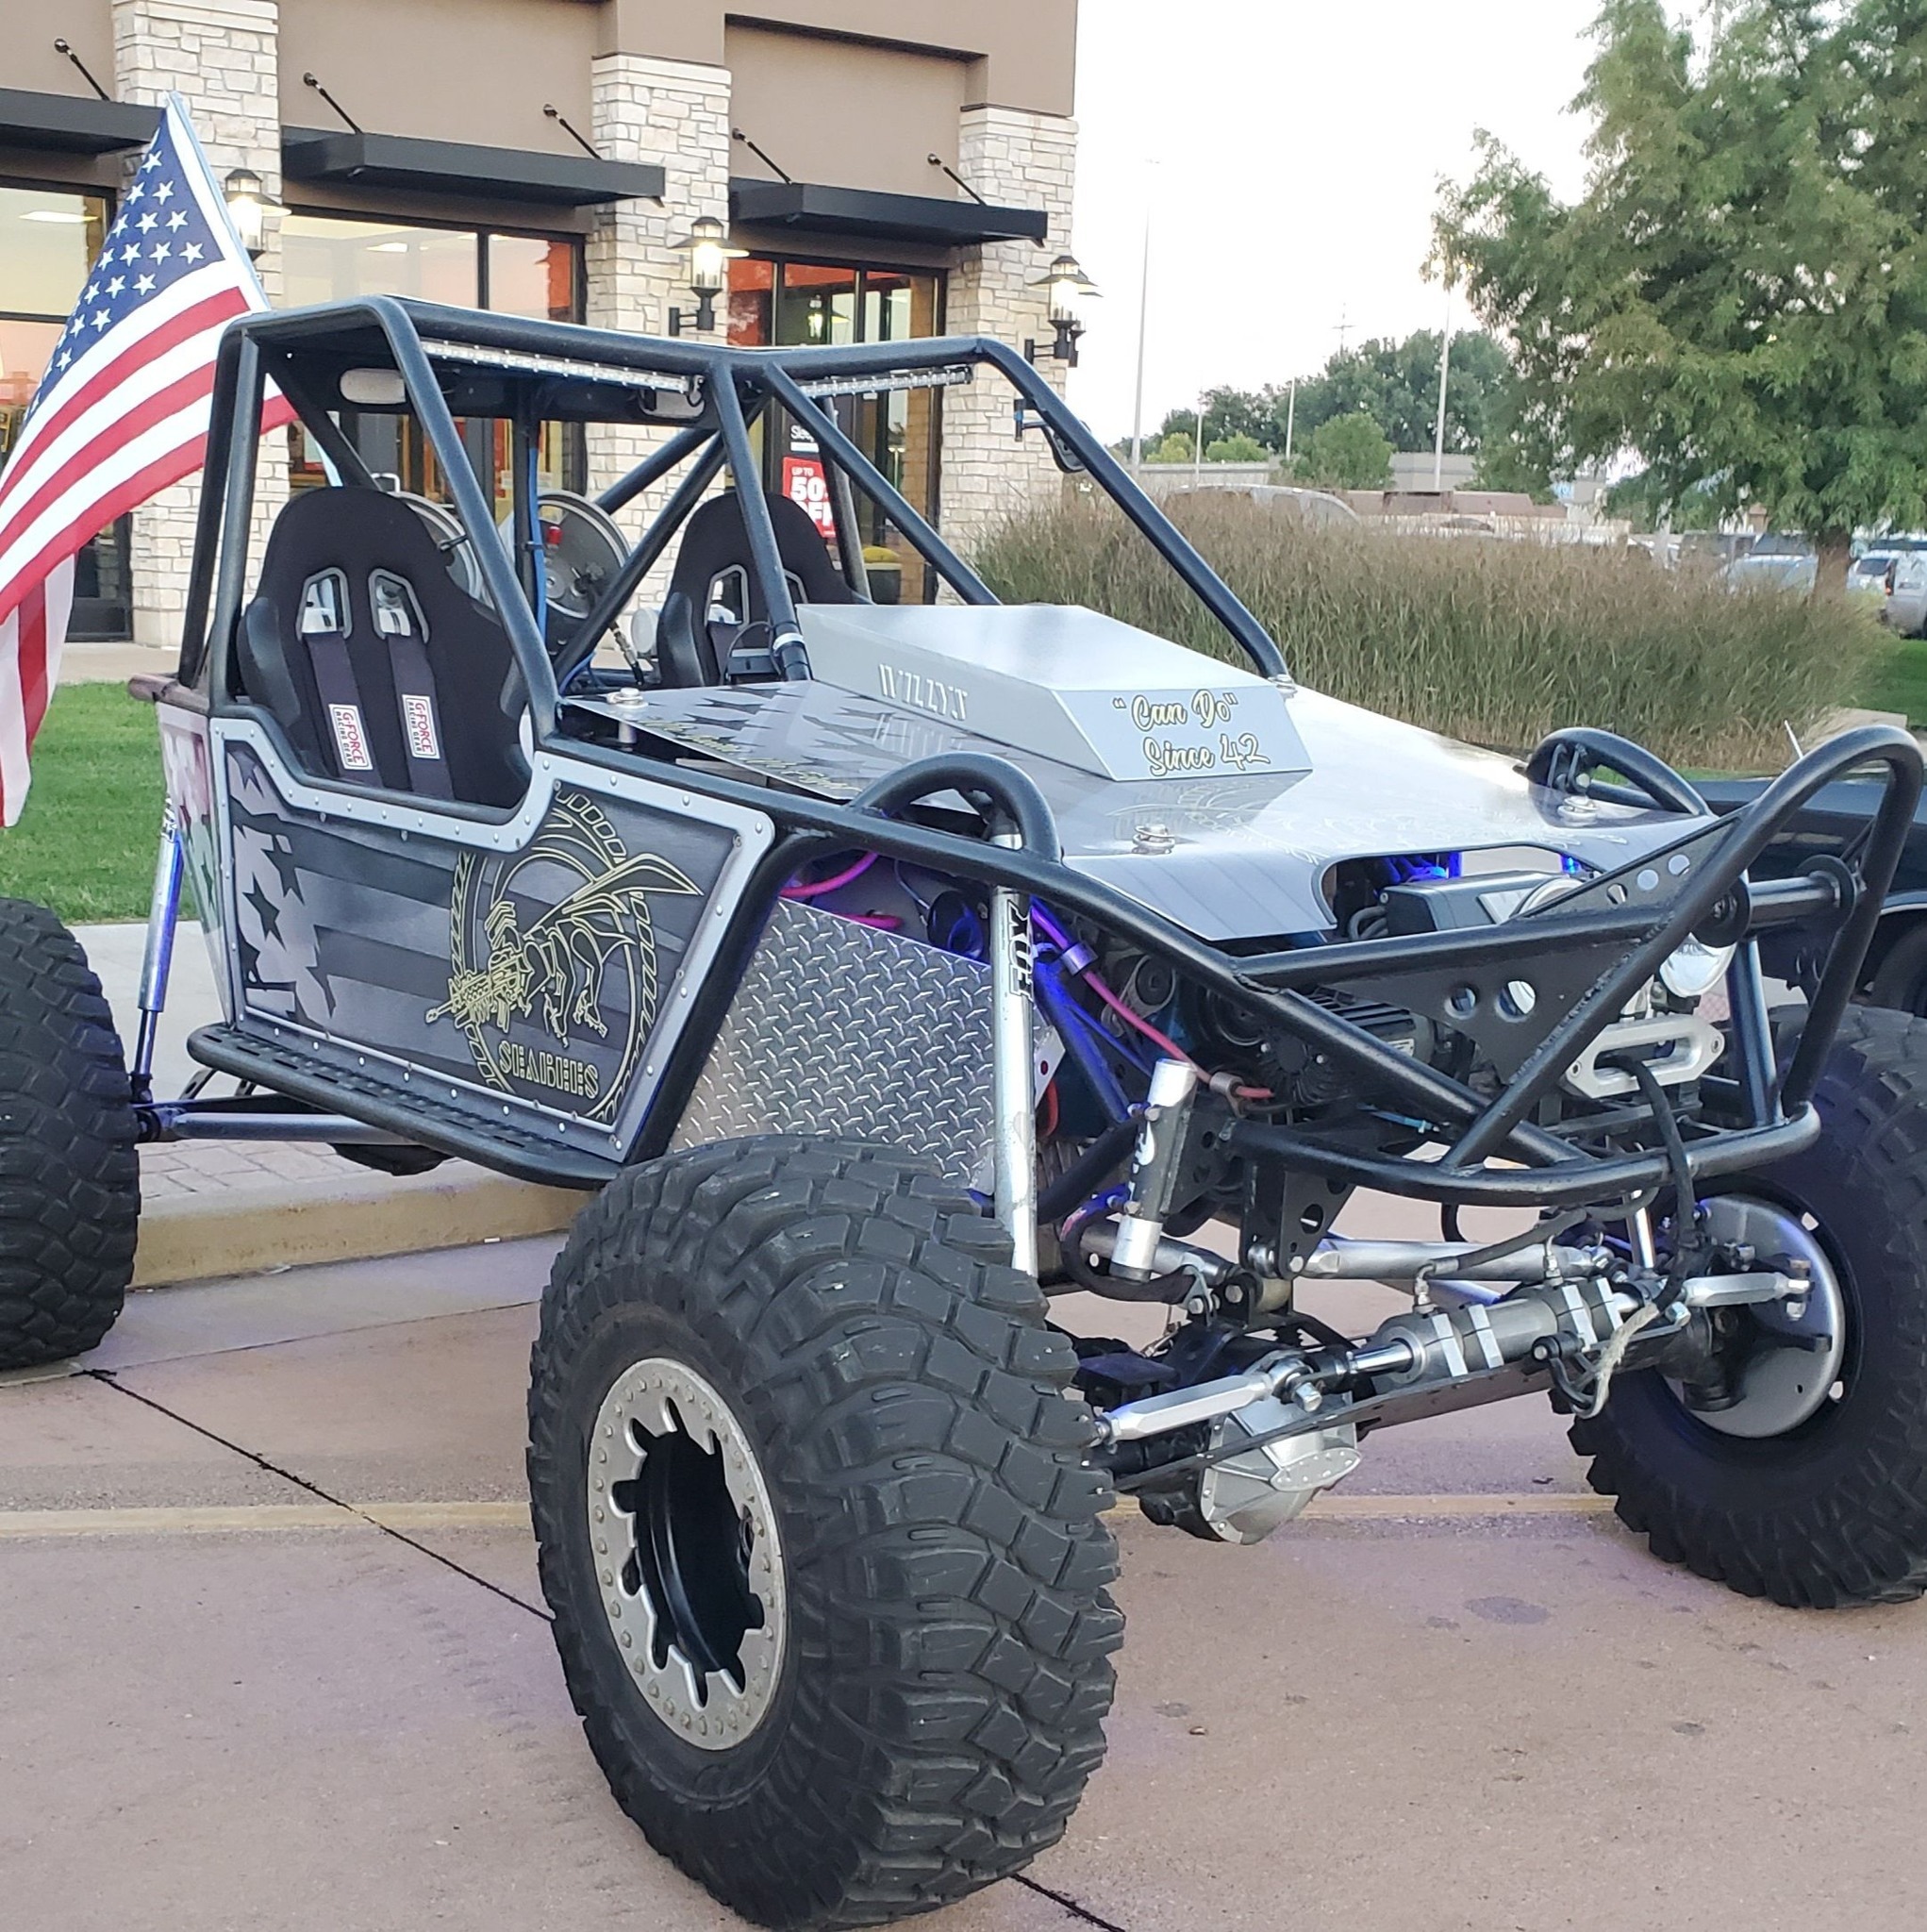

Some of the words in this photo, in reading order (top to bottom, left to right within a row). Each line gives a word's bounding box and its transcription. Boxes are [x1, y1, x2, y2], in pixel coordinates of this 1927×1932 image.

[790, 475, 829, 502] 50
[335, 710, 349, 740] RACING
[342, 741, 355, 763] GEAR
[407, 700, 419, 729] RACING
[412, 731, 423, 752] GEAR
[1143, 736, 1216, 777] Since
[1220, 732, 1271, 772] 42
[1006, 898, 1036, 1002] FOX
[498, 1040, 600, 1100] SEABEES
